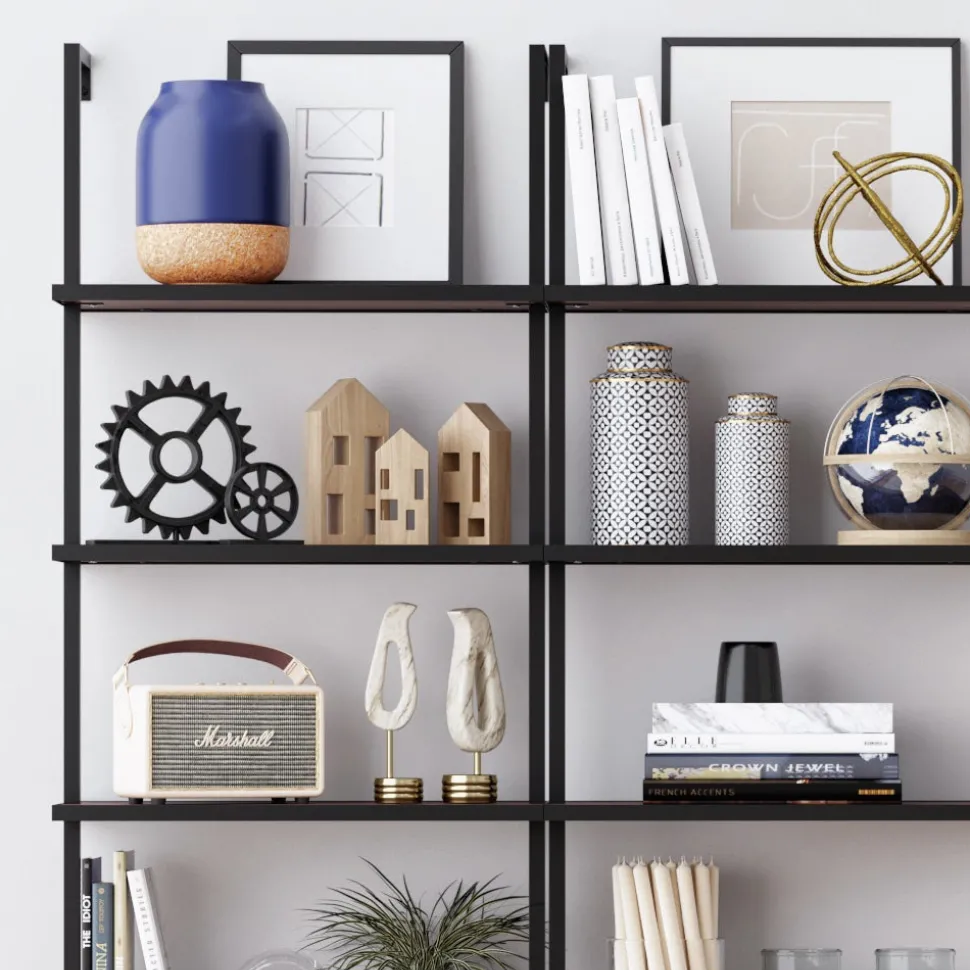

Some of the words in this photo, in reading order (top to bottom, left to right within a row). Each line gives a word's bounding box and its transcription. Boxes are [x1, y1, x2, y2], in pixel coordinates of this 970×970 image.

[194, 724, 275, 748] Marshall
[708, 763, 778, 772] CROWN
[785, 763, 846, 773] JEWEL
[648, 788, 686, 796] FRENCH
[690, 788, 736, 797] ACCENTS
[82, 894, 92, 923] IDIOT
[82, 930, 92, 949] THE
